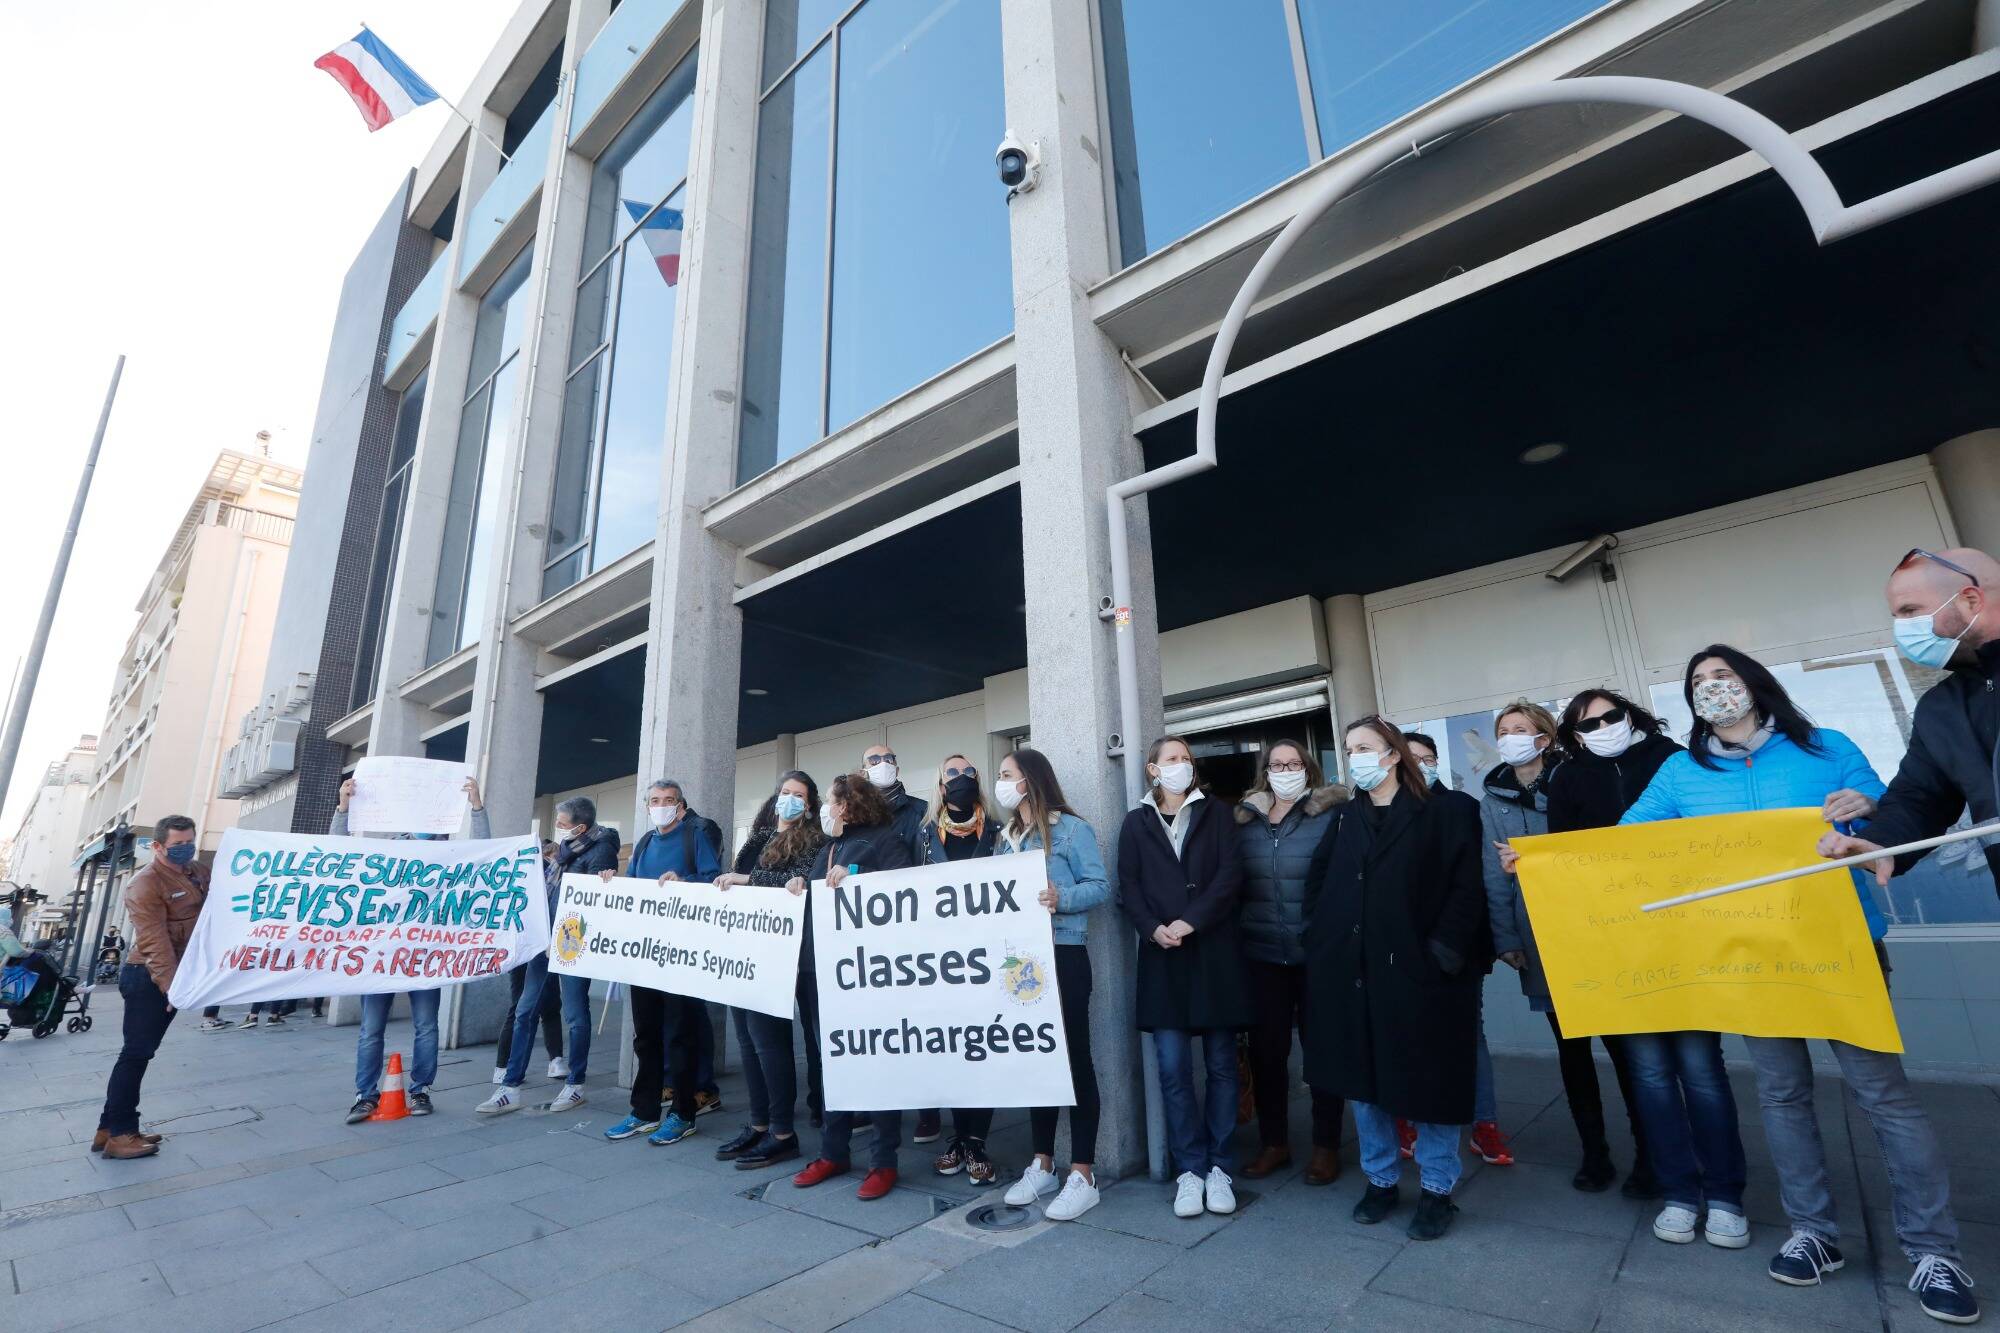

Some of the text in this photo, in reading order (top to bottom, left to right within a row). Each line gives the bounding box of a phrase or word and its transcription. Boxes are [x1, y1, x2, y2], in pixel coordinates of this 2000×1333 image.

[231, 846, 539, 893] COLLÈGE SURCHARGÉ
[1648, 850, 1680, 859] aux
[250, 877, 359, 928] ÉLÈVES
[402, 888, 528, 932] DANGER
[564, 885, 794, 936] Pour une meilleure répartition
[834, 879, 1021, 930] Non aux
[407, 927, 495, 945] CHANGER
[590, 932, 756, 980] des collégiens Seynois
[390, 947, 508, 978] RECRUTER
[836, 946, 991, 990] classes
[1614, 963, 1680, 988] CARTE
[829, 1014, 1056, 1061] surchargées
